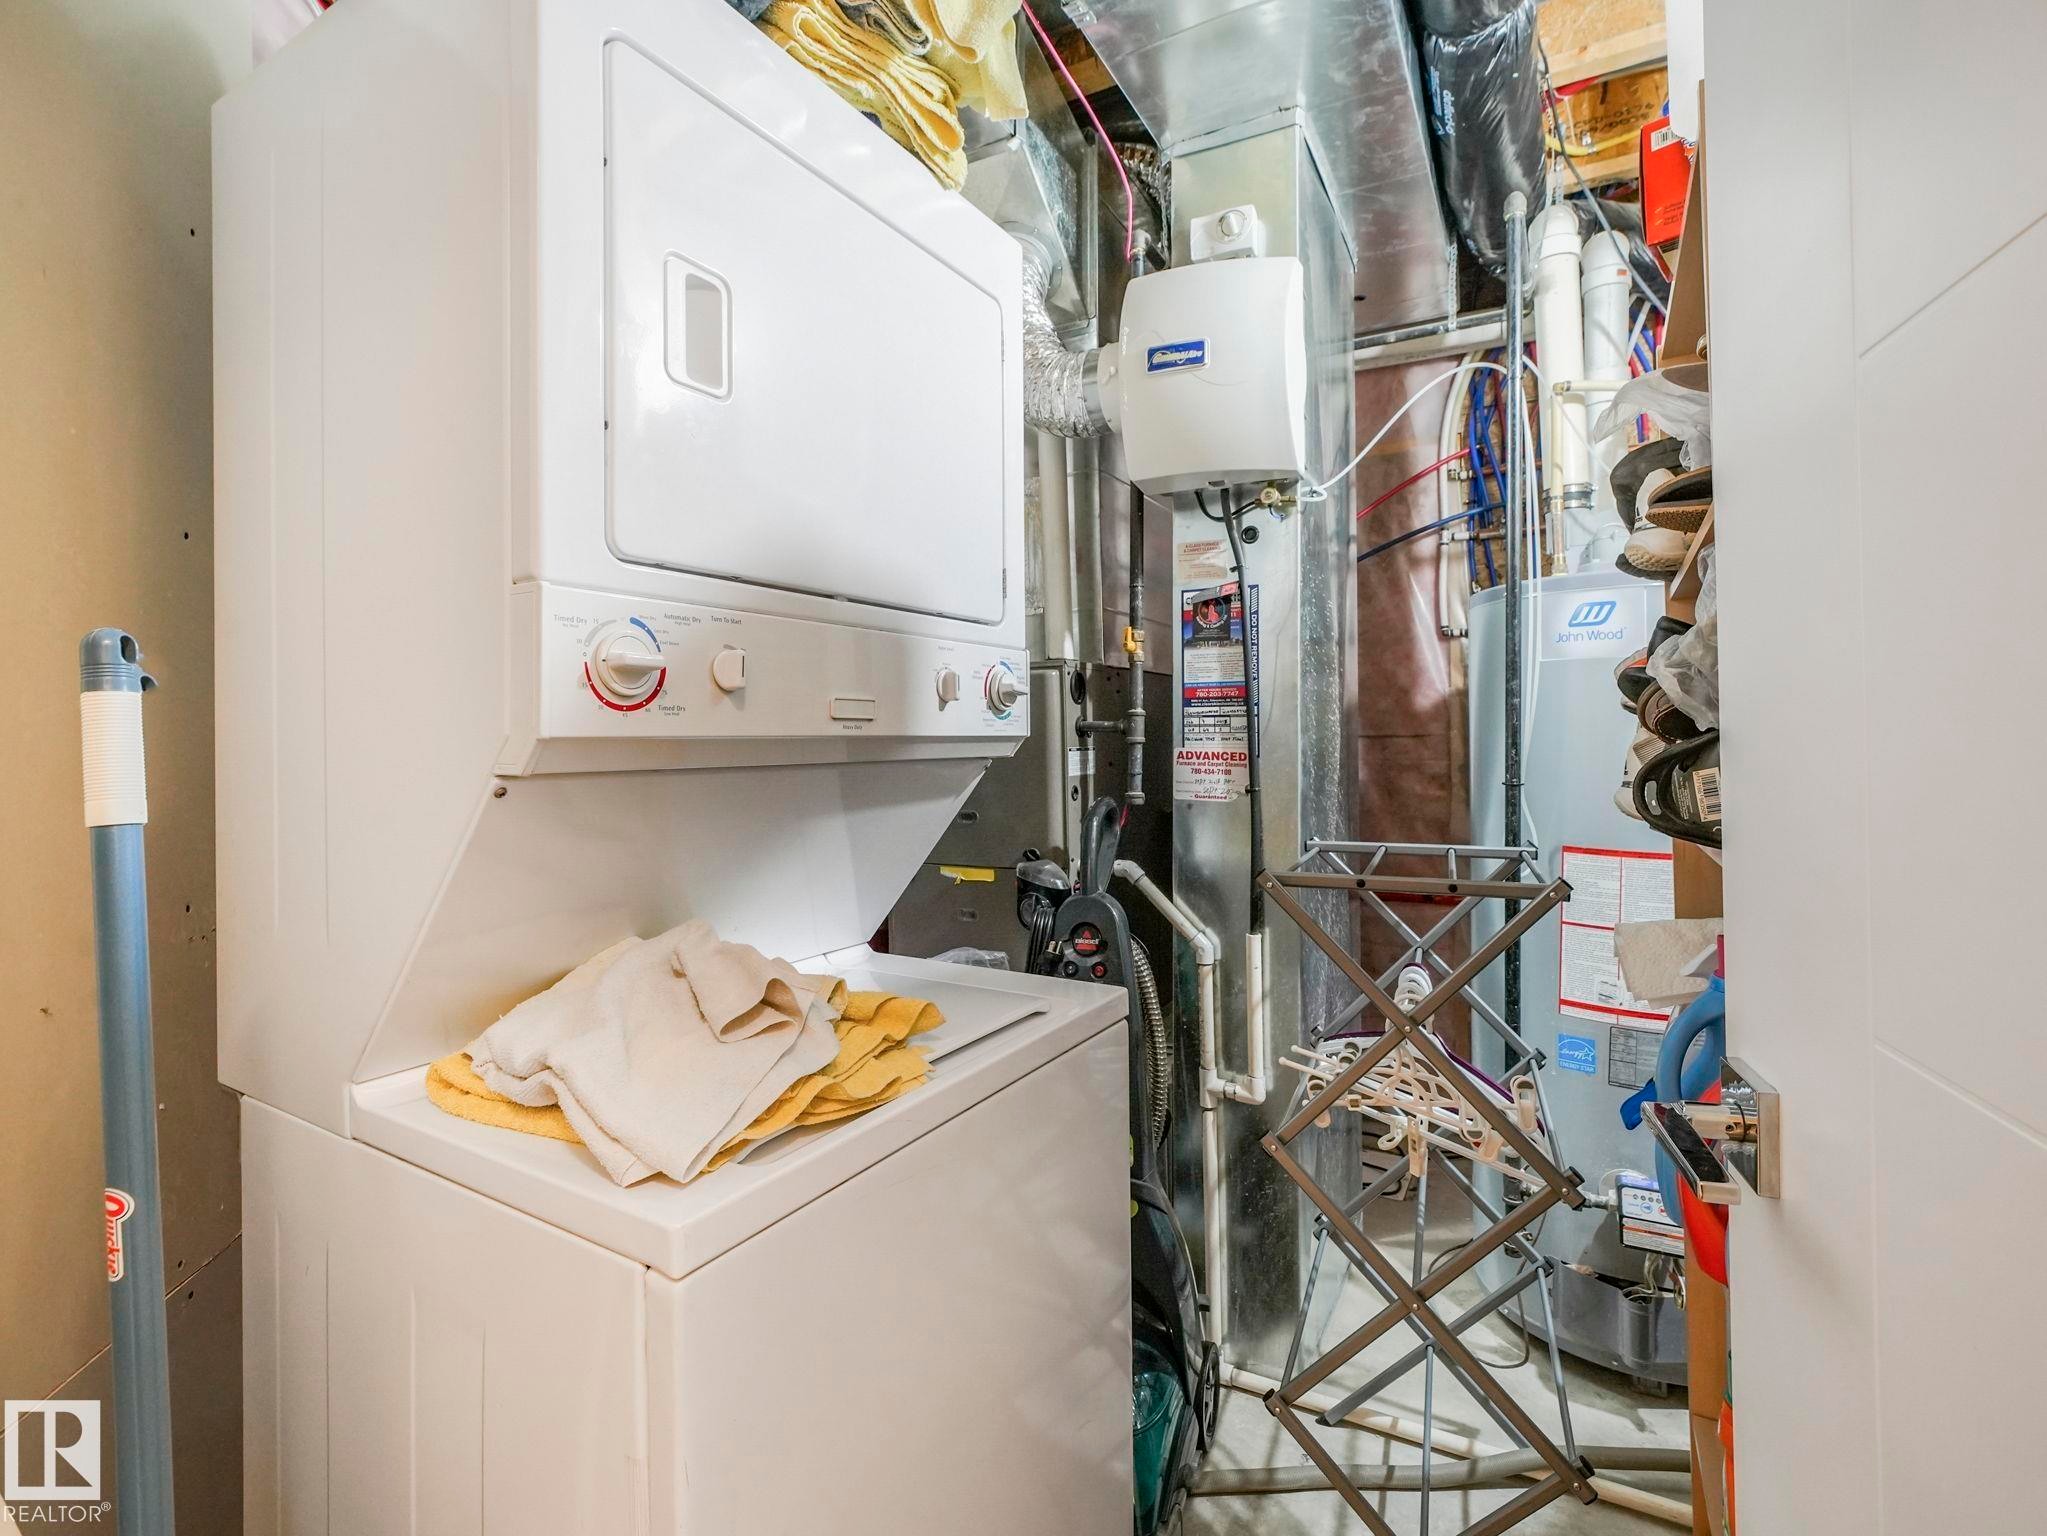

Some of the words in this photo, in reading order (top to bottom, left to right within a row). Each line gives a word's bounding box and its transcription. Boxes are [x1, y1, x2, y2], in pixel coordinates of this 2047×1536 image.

[554, 614, 573, 623] Timed
[577, 616, 588, 625] Dry
[663, 612, 691, 622] Automatic
[692, 616, 701, 624] Dry
[1251, 614, 1257, 626] DO
[1555, 631, 1584, 643] John
[1586, 628, 1624, 641] Wood
[658, 704, 675, 712] Timed
[1176, 751, 1248, 761] ADVANCED
